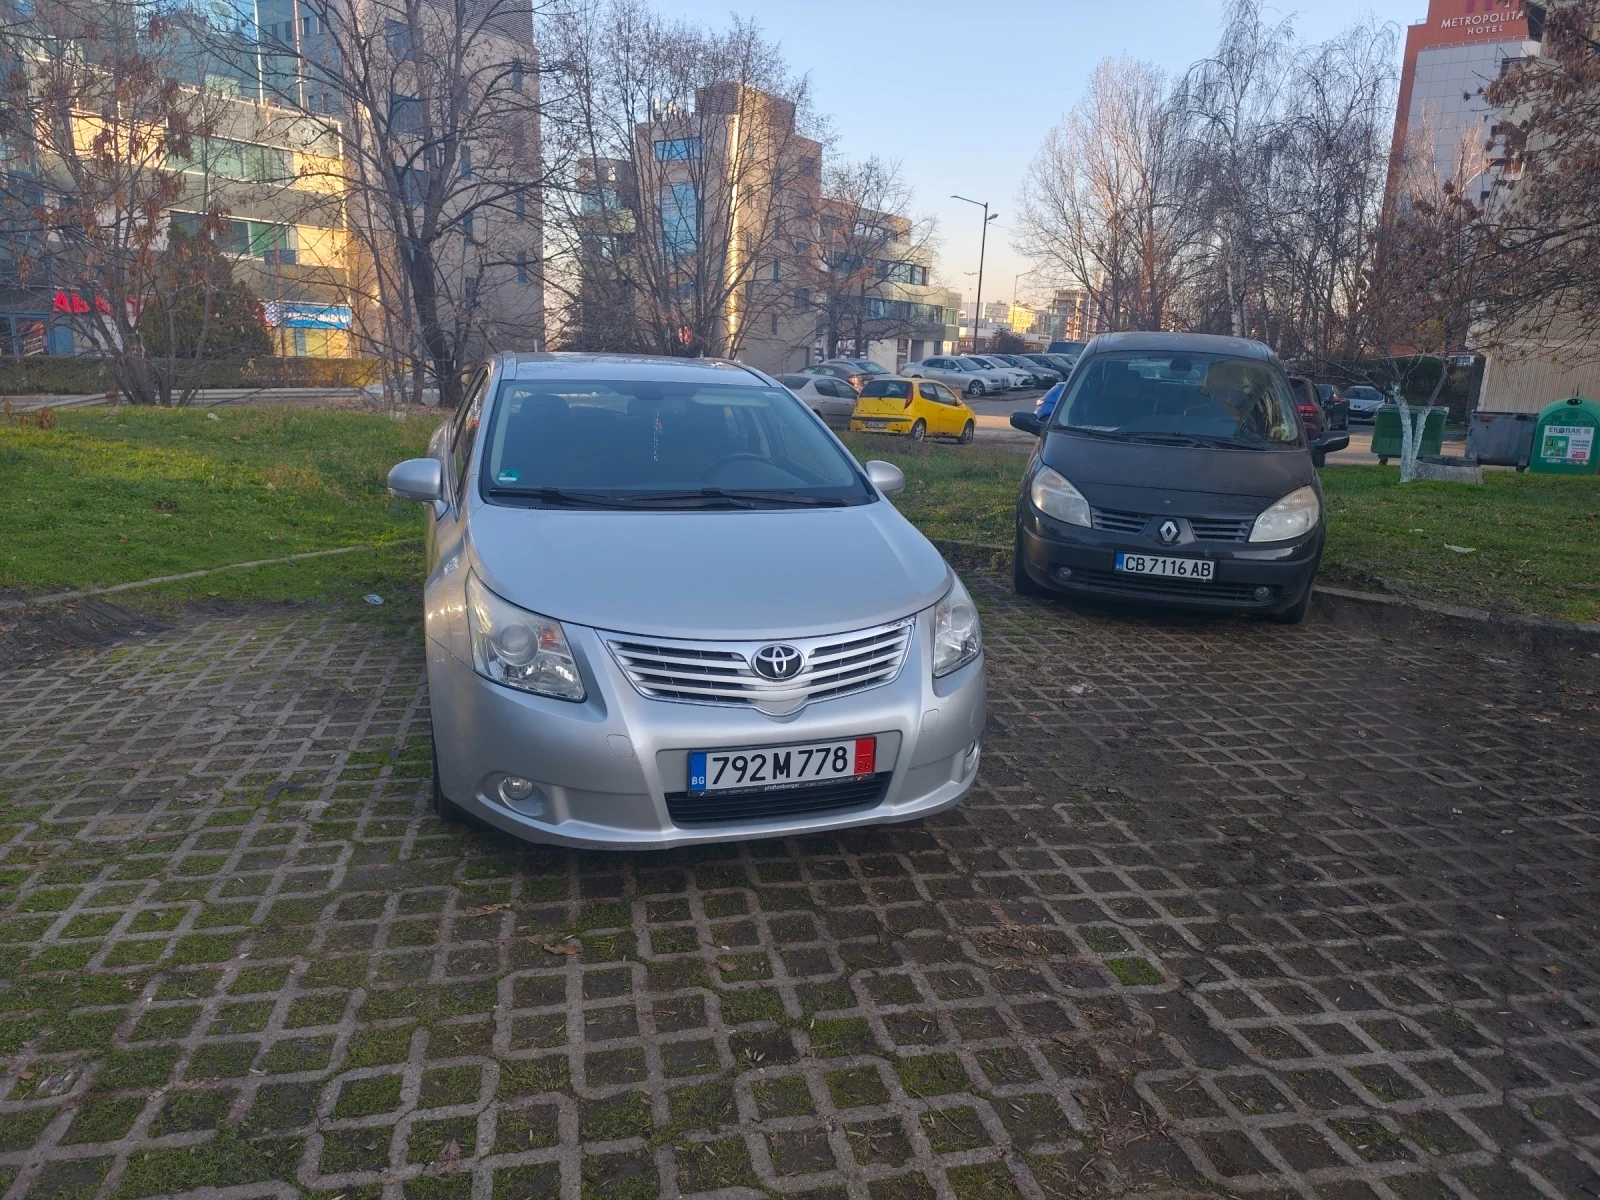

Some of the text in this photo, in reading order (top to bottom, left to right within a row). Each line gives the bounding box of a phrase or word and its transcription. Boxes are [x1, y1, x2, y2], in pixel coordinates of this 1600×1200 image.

[1440, 10, 1524, 29] METROPOLITA
[1467, 25, 1504, 36] HOTEL
[1125, 556, 1211, 577] CB 7116 AB
[712, 754, 767, 785] 792
[797, 746, 848, 777] 778
[858, 760, 870, 771] 26
[691, 776, 705, 785] BG
